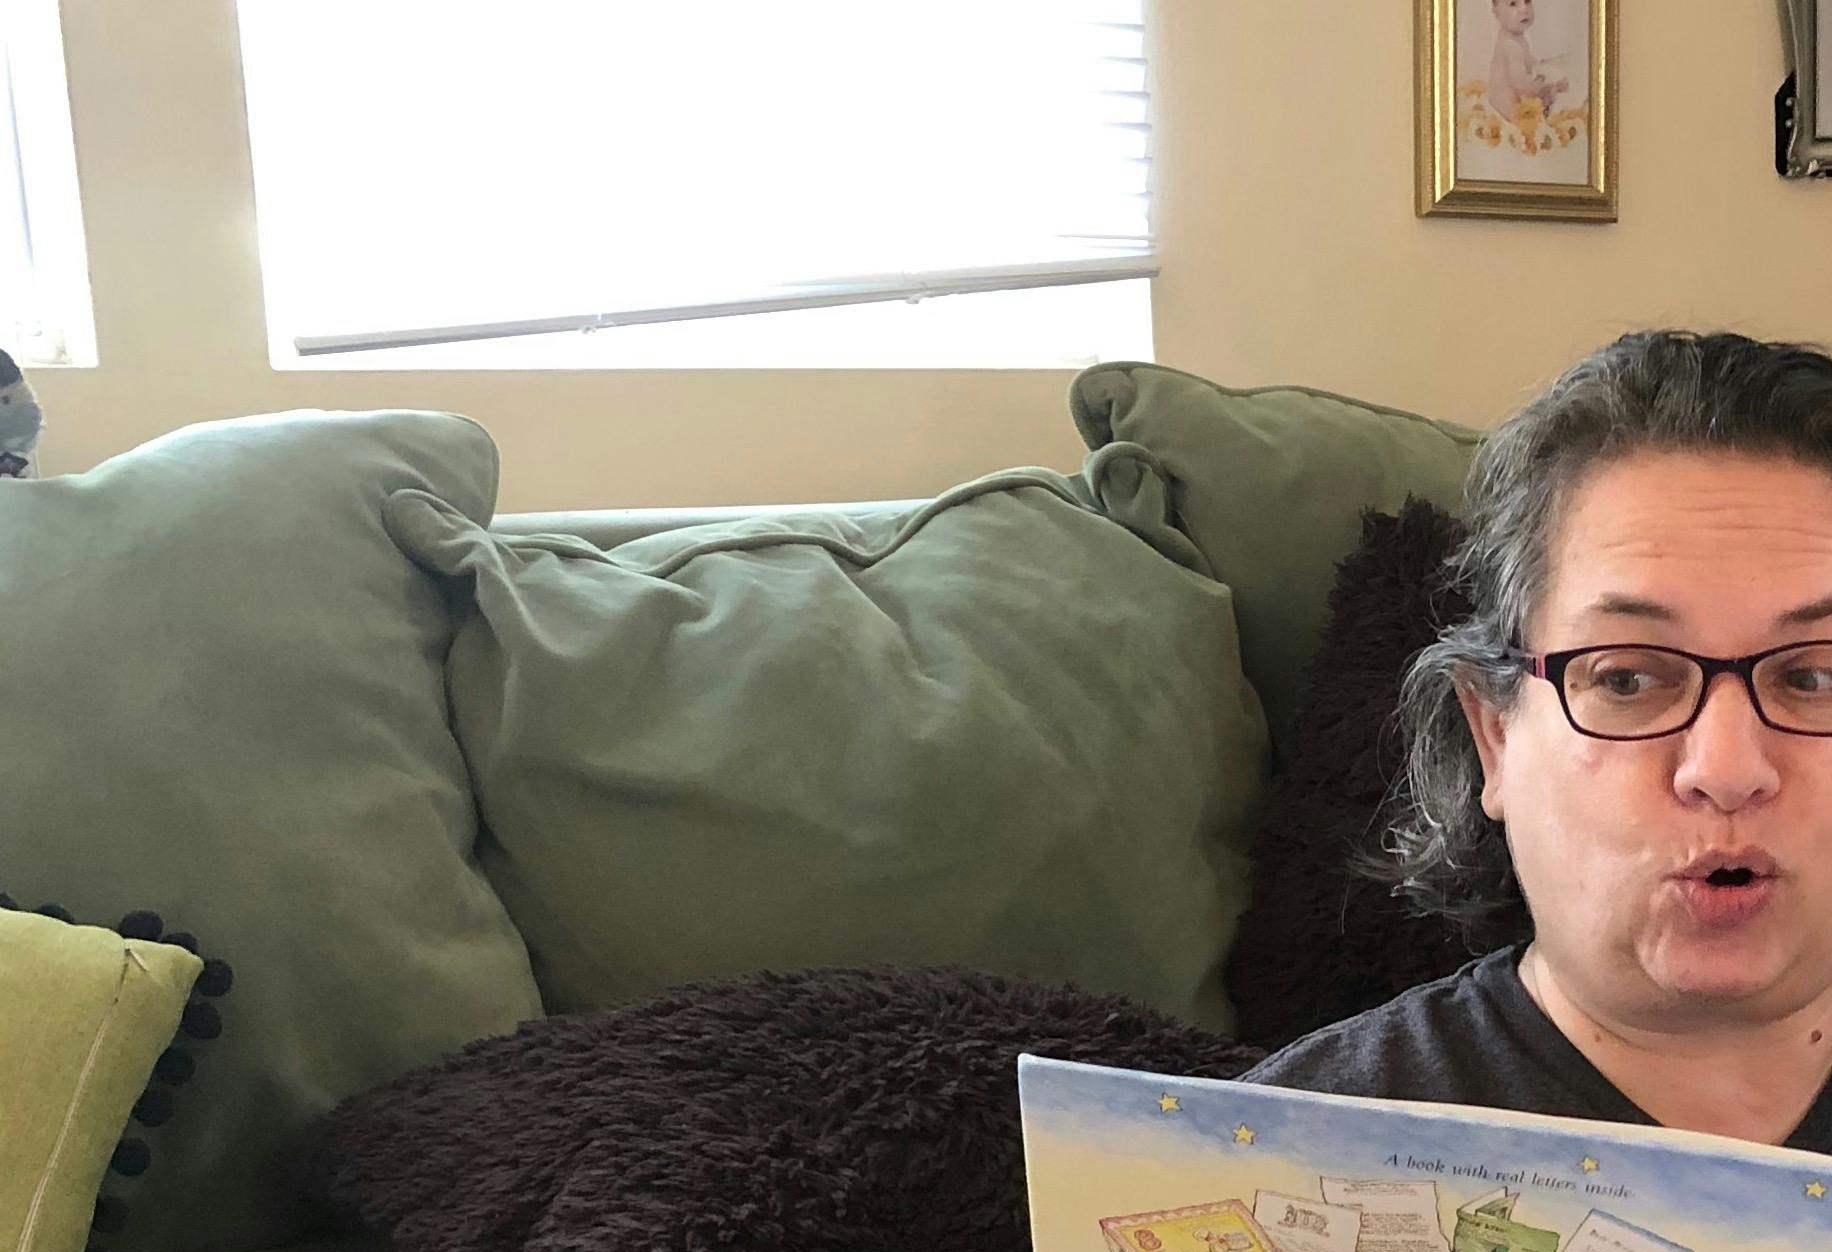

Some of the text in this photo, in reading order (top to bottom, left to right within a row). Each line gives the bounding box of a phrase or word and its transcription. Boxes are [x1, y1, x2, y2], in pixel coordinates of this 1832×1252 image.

[1384, 1153, 1399, 1166] A
[1406, 1155, 1446, 1174] book
[1452, 1163, 1489, 1180] with
[1495, 1170, 1526, 1184] real
[1531, 1172, 1578, 1191] letters
